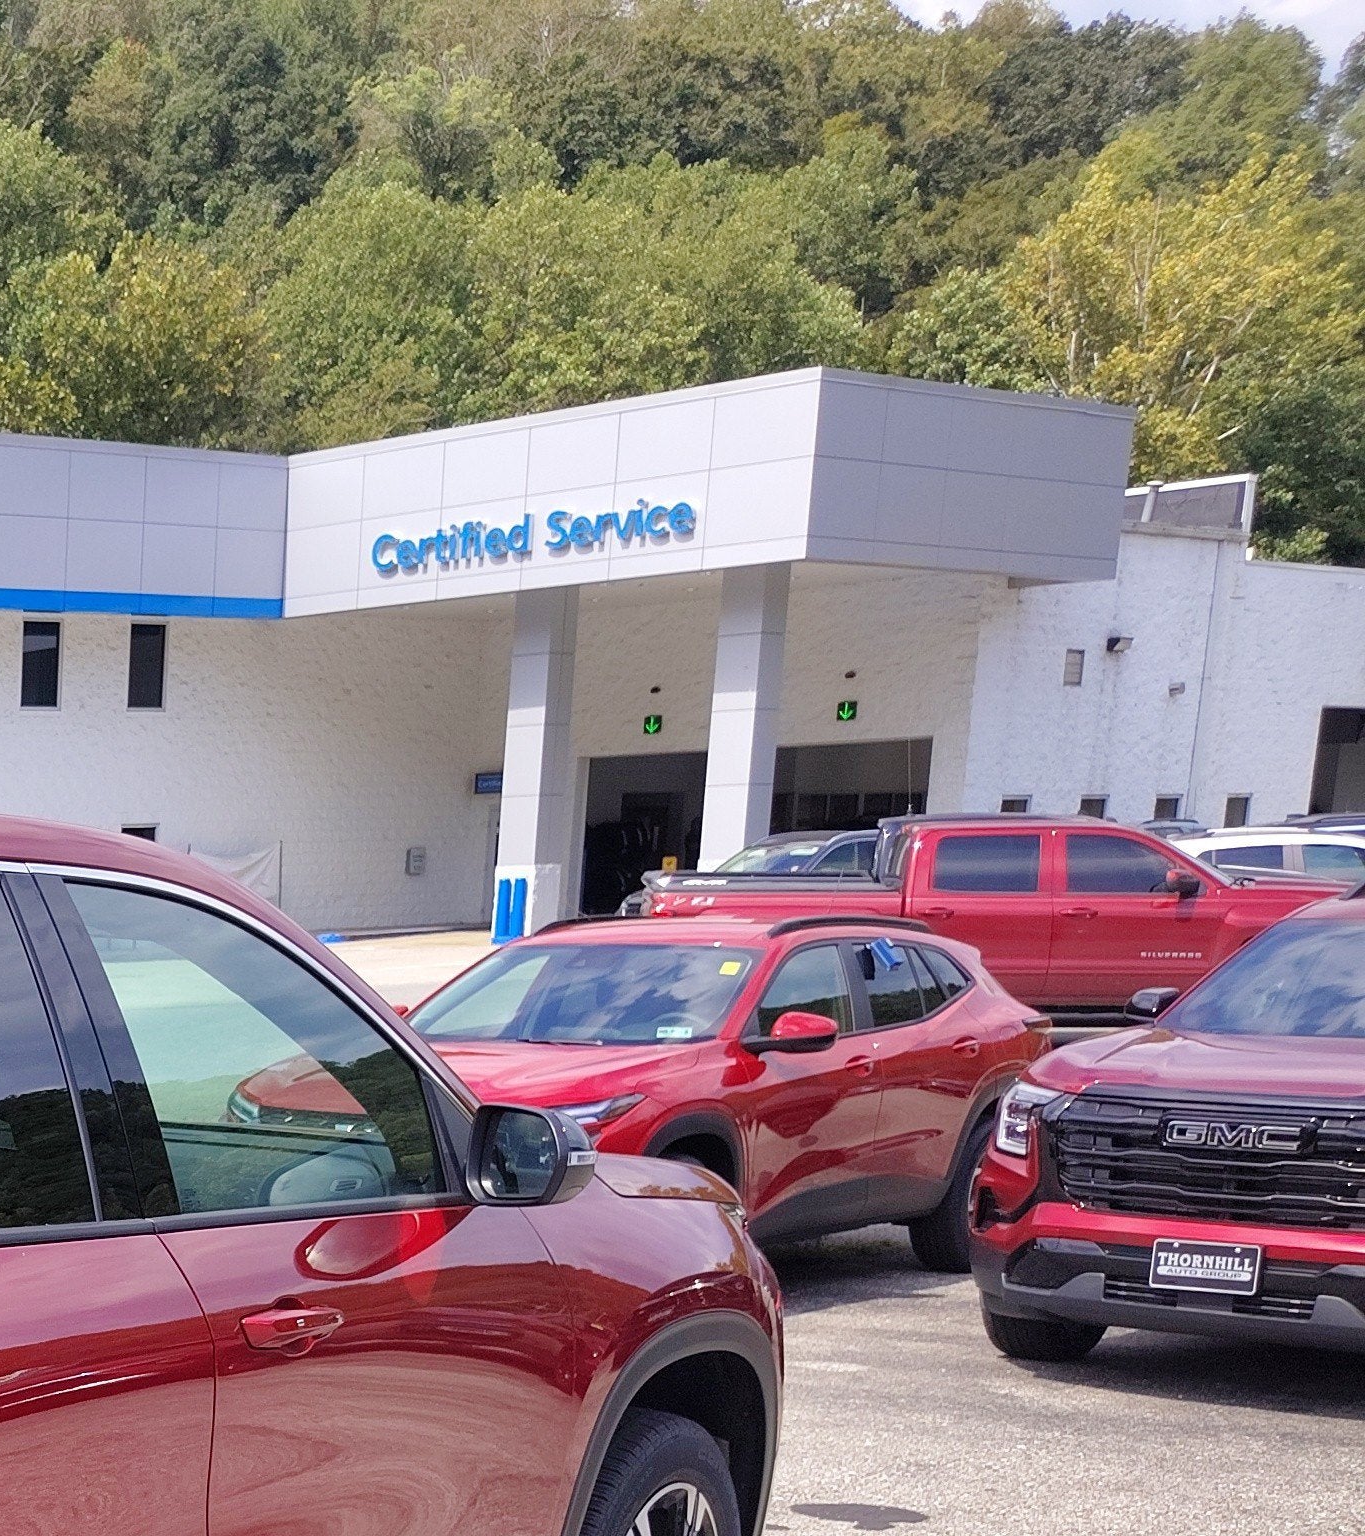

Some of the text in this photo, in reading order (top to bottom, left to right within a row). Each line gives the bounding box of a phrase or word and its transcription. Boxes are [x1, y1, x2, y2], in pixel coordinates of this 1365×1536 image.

[371, 498, 696, 571] Certified Service
[1166, 1120, 1303, 1151] GMC
[1157, 1251, 1255, 1272] THORNHILL
[1166, 1268, 1242, 1279] AUTO GROUP
